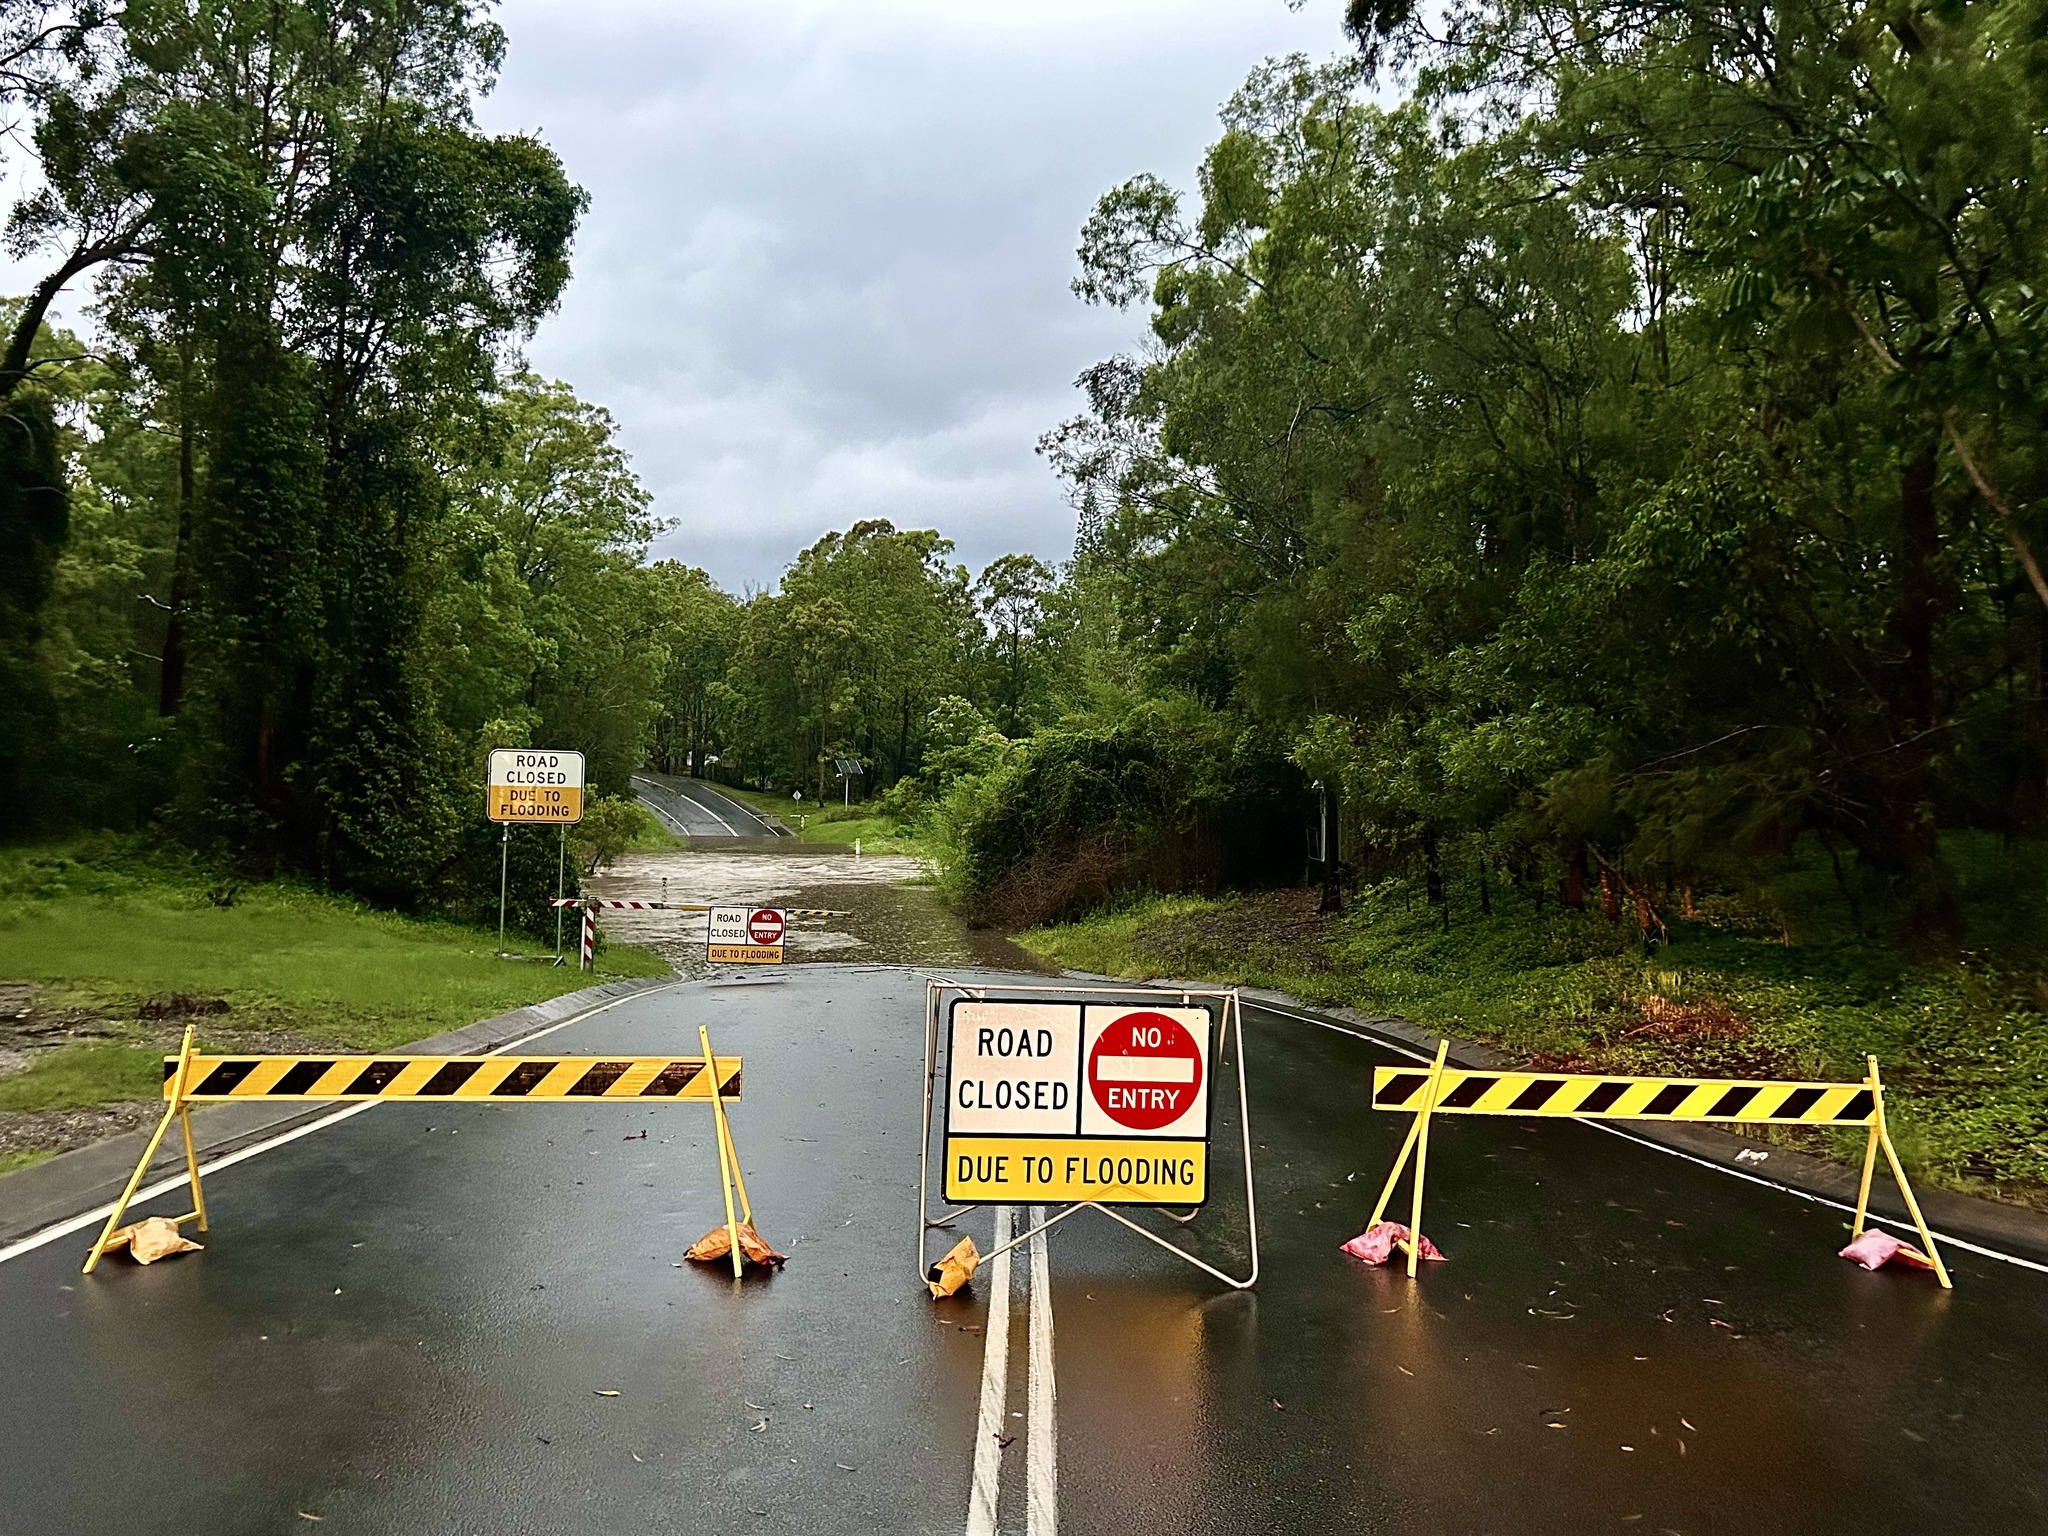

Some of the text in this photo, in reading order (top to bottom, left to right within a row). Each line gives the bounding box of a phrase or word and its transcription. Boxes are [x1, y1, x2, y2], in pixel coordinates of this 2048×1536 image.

[516, 755, 558, 767] ROAD
[506, 771, 566, 784] CLOSED
[510, 790, 560, 802] DUE TO
[501, 804, 569, 816] FLOODING
[716, 914, 741, 922] ROAD
[710, 929, 745, 937] CLOSED
[754, 931, 777, 939] ENTRY
[711, 949, 779, 959] DUE TO FLOODING
[978, 1028, 1052, 1057] ROAD
[1132, 1027, 1161, 1047] NO
[958, 1079, 1068, 1110] CLOSED
[1108, 1088, 1180, 1109] ENTRY
[958, 1155, 1194, 1186] DUE TO FLOODING
